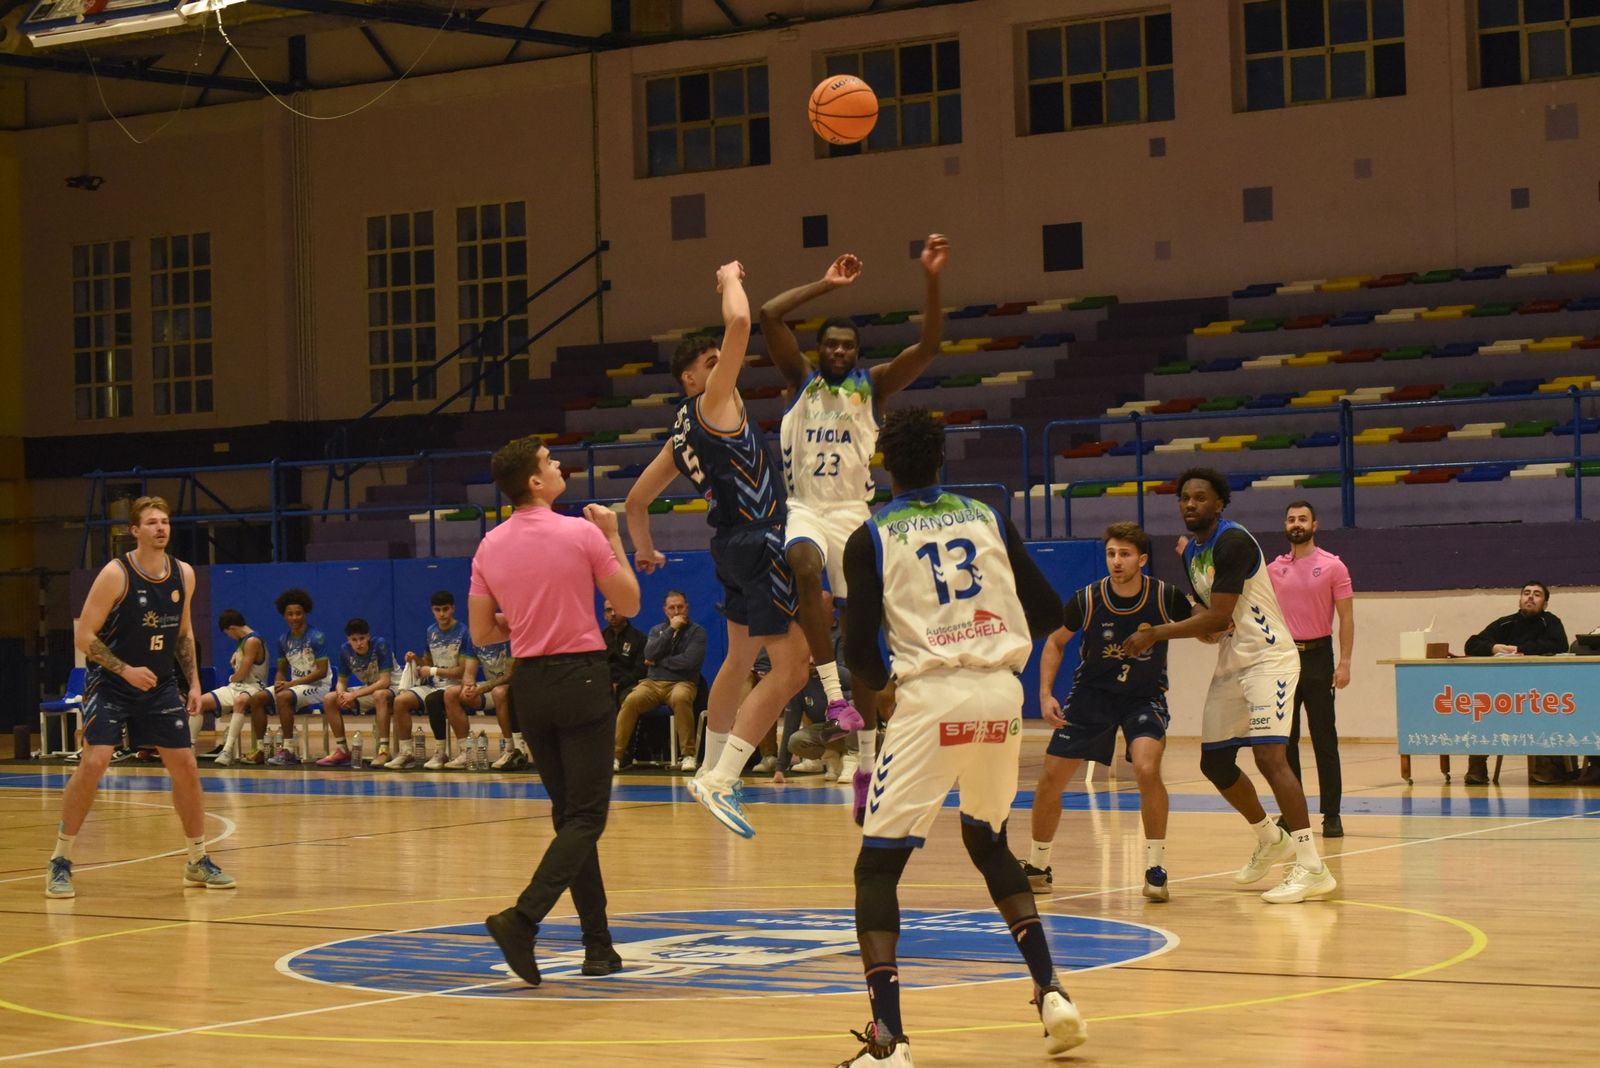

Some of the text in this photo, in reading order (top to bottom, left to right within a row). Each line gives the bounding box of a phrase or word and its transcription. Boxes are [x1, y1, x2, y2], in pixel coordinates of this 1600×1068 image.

[806, 426, 852, 444] TÍOLA
[813, 453, 841, 477] 23
[886, 508, 987, 536] KOYANOUBA
[915, 538, 982, 606] 13
[926, 620, 973, 636] Autocares
[927, 622, 1008, 647] BONACHELA
[150, 634, 165, 651] 15
[1116, 663, 1130, 682] 3
[1433, 685, 1576, 722] deportes
[1297, 834, 1310, 843] 23
